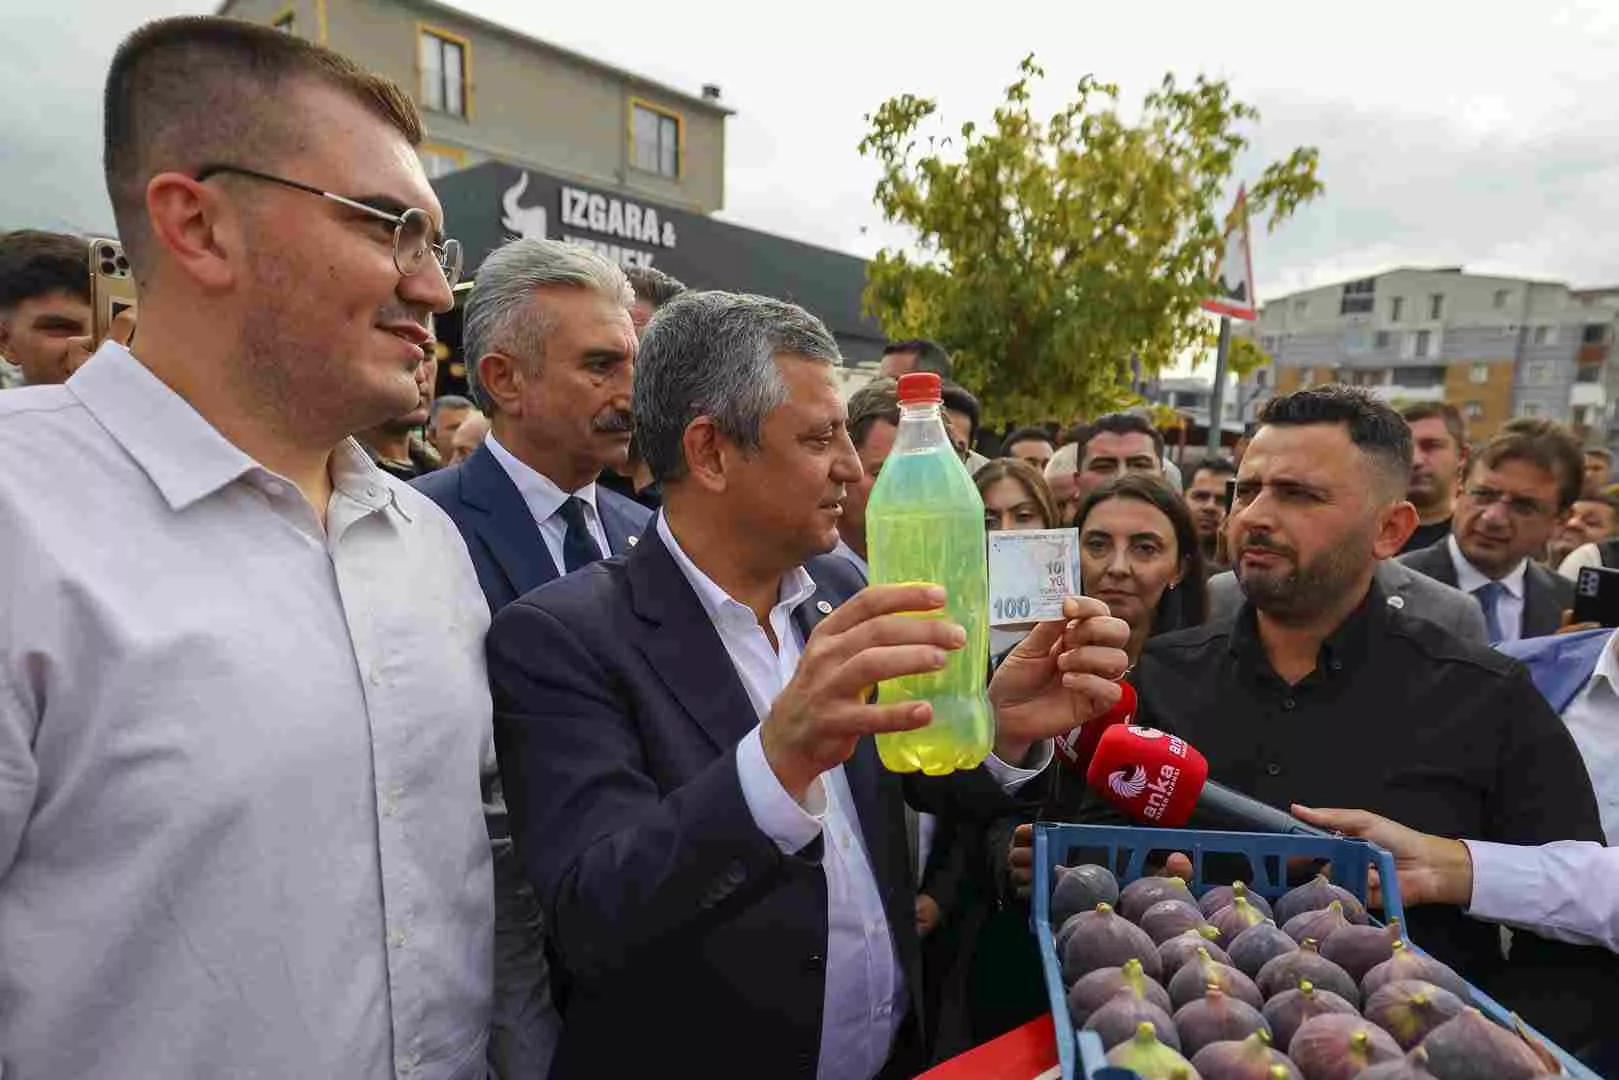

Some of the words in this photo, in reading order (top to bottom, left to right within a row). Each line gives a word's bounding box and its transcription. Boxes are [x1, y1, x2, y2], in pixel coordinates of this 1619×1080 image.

[561, 186, 660, 245] IZGARA
[661, 221, 677, 248] &
[993, 596, 1031, 619] 100
[1143, 764, 1176, 818] anka
